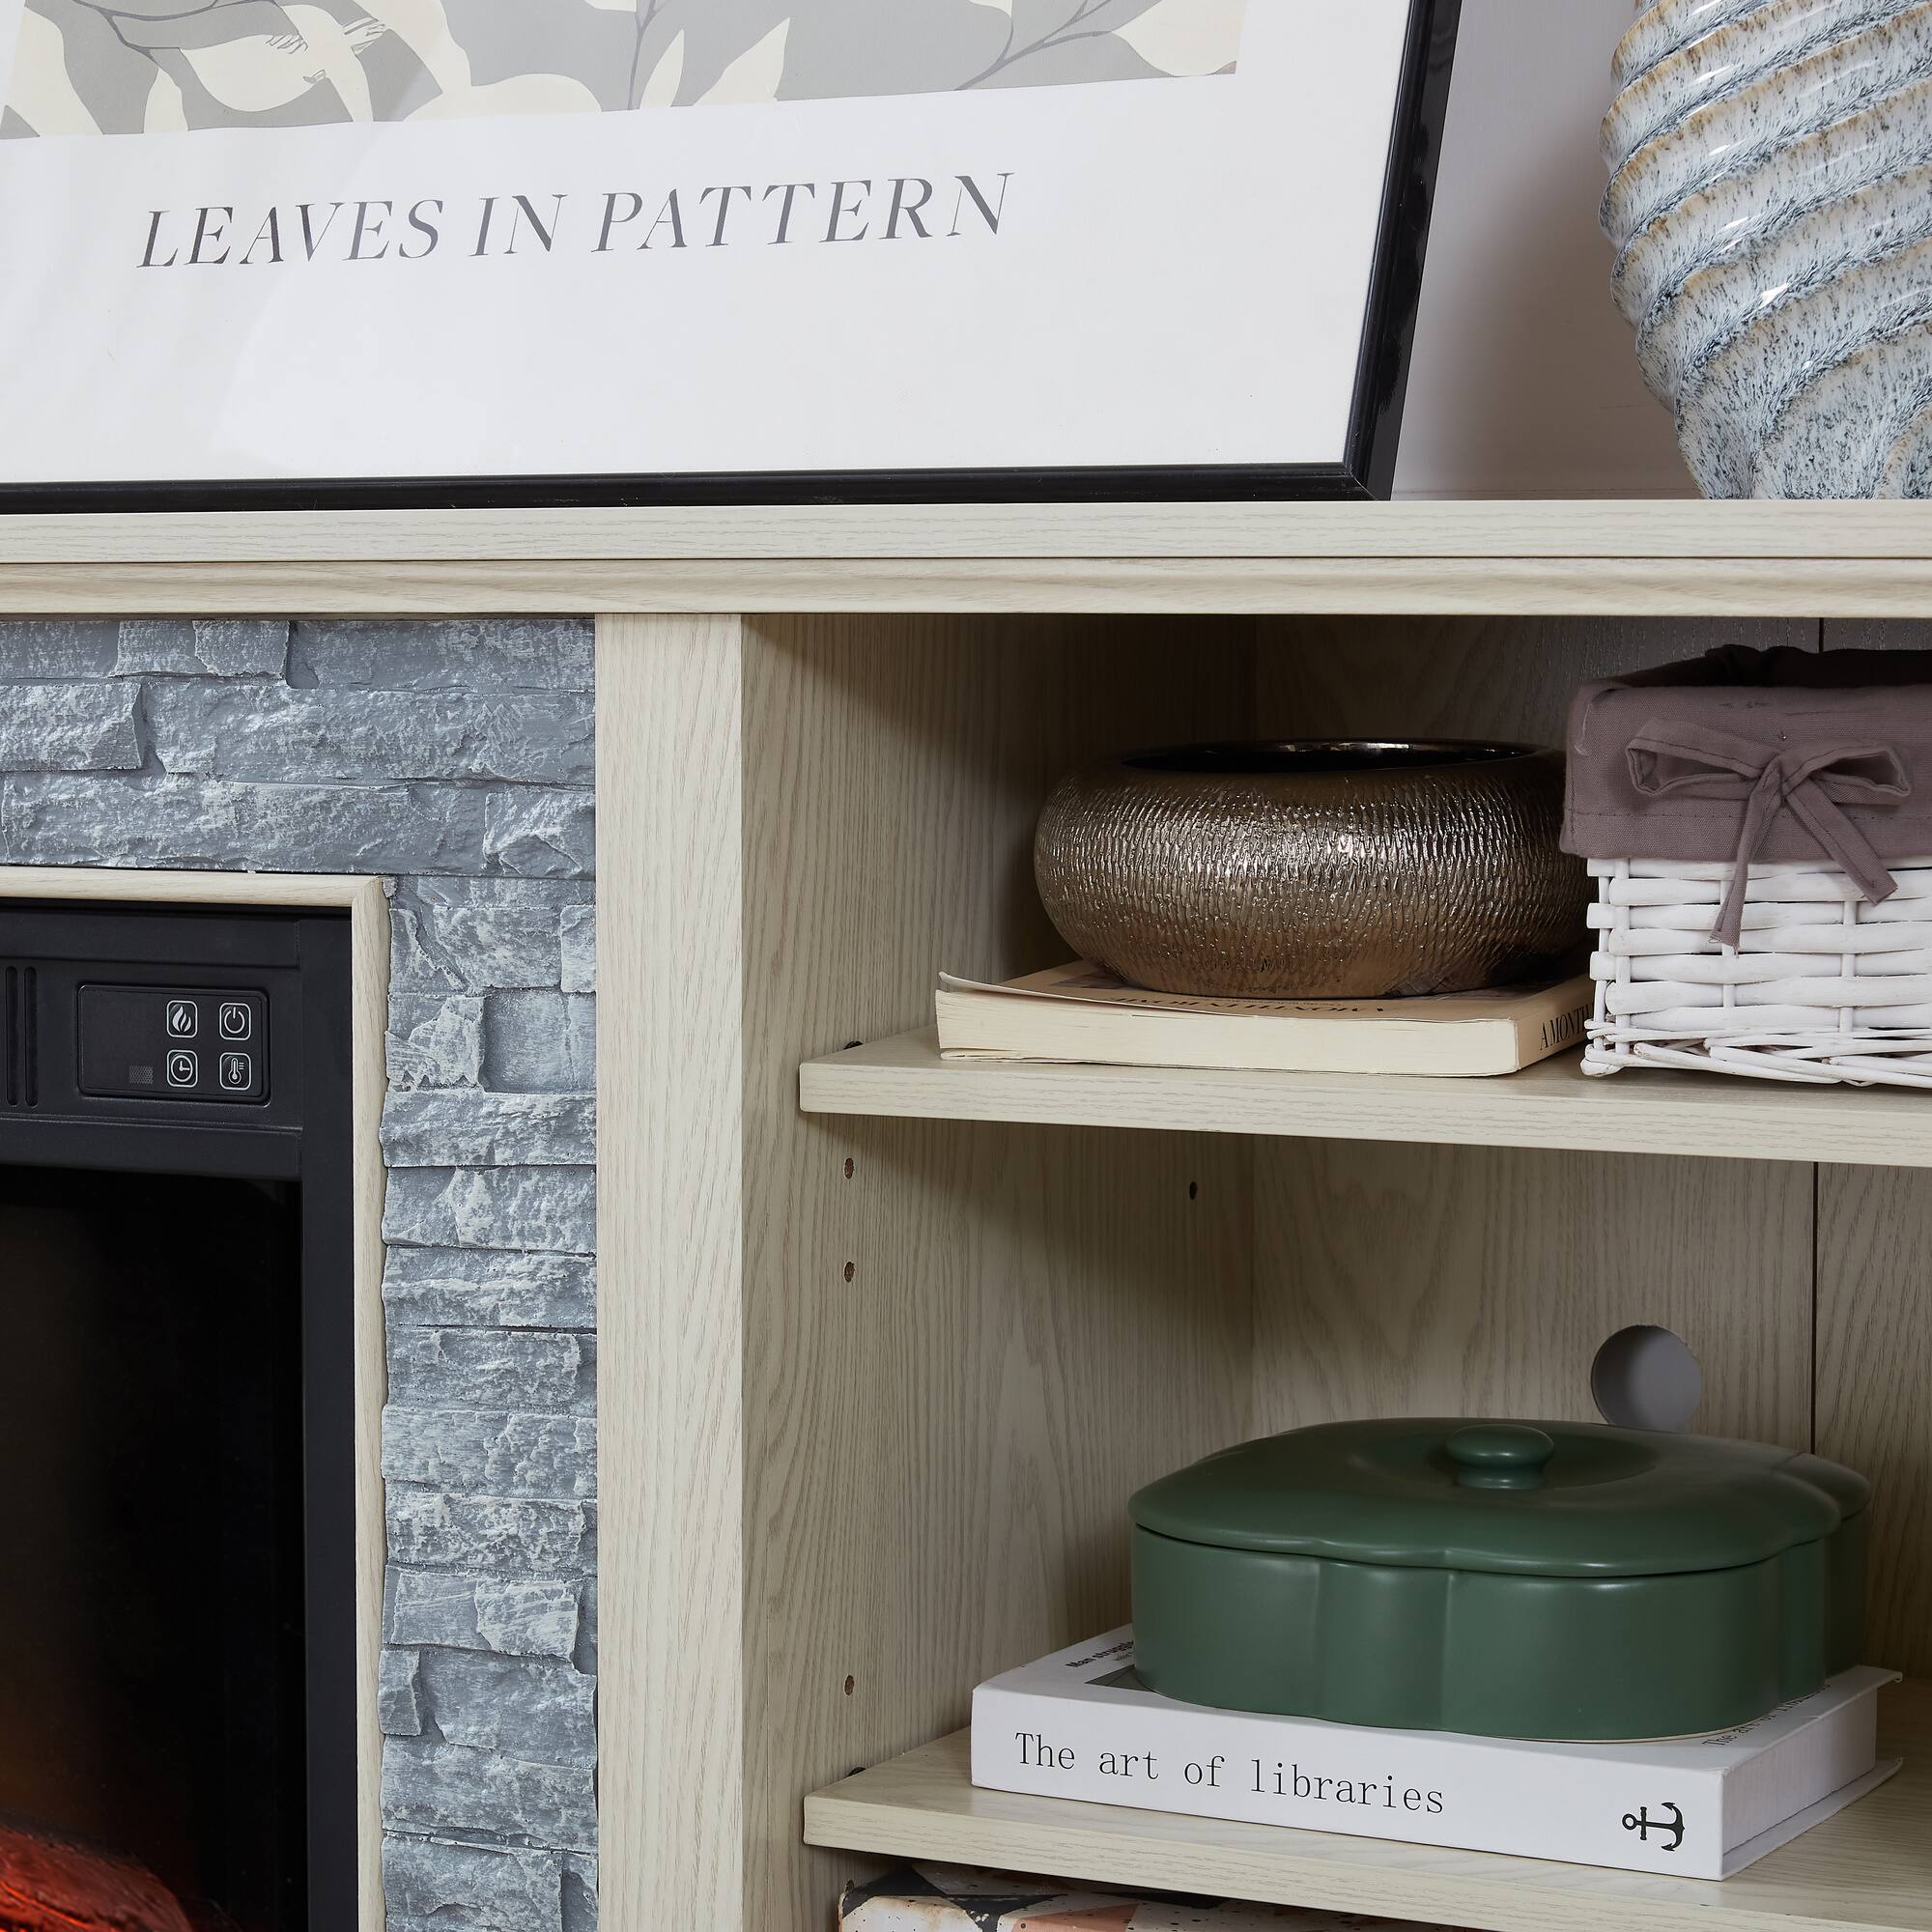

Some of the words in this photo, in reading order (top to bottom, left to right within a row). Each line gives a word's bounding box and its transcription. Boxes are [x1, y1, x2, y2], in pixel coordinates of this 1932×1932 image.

[136, 199, 443, 269] LEAVES
[469, 194, 568, 257] IN
[590, 172, 1014, 253] PATTERN
[1540, 1021, 1548, 1051] A
[1015, 1732, 1075, 1770] The
[1098, 1750, 1159, 1780] art
[1183, 1756, 1226, 1788] of
[1251, 1758, 1443, 1814] libraries
